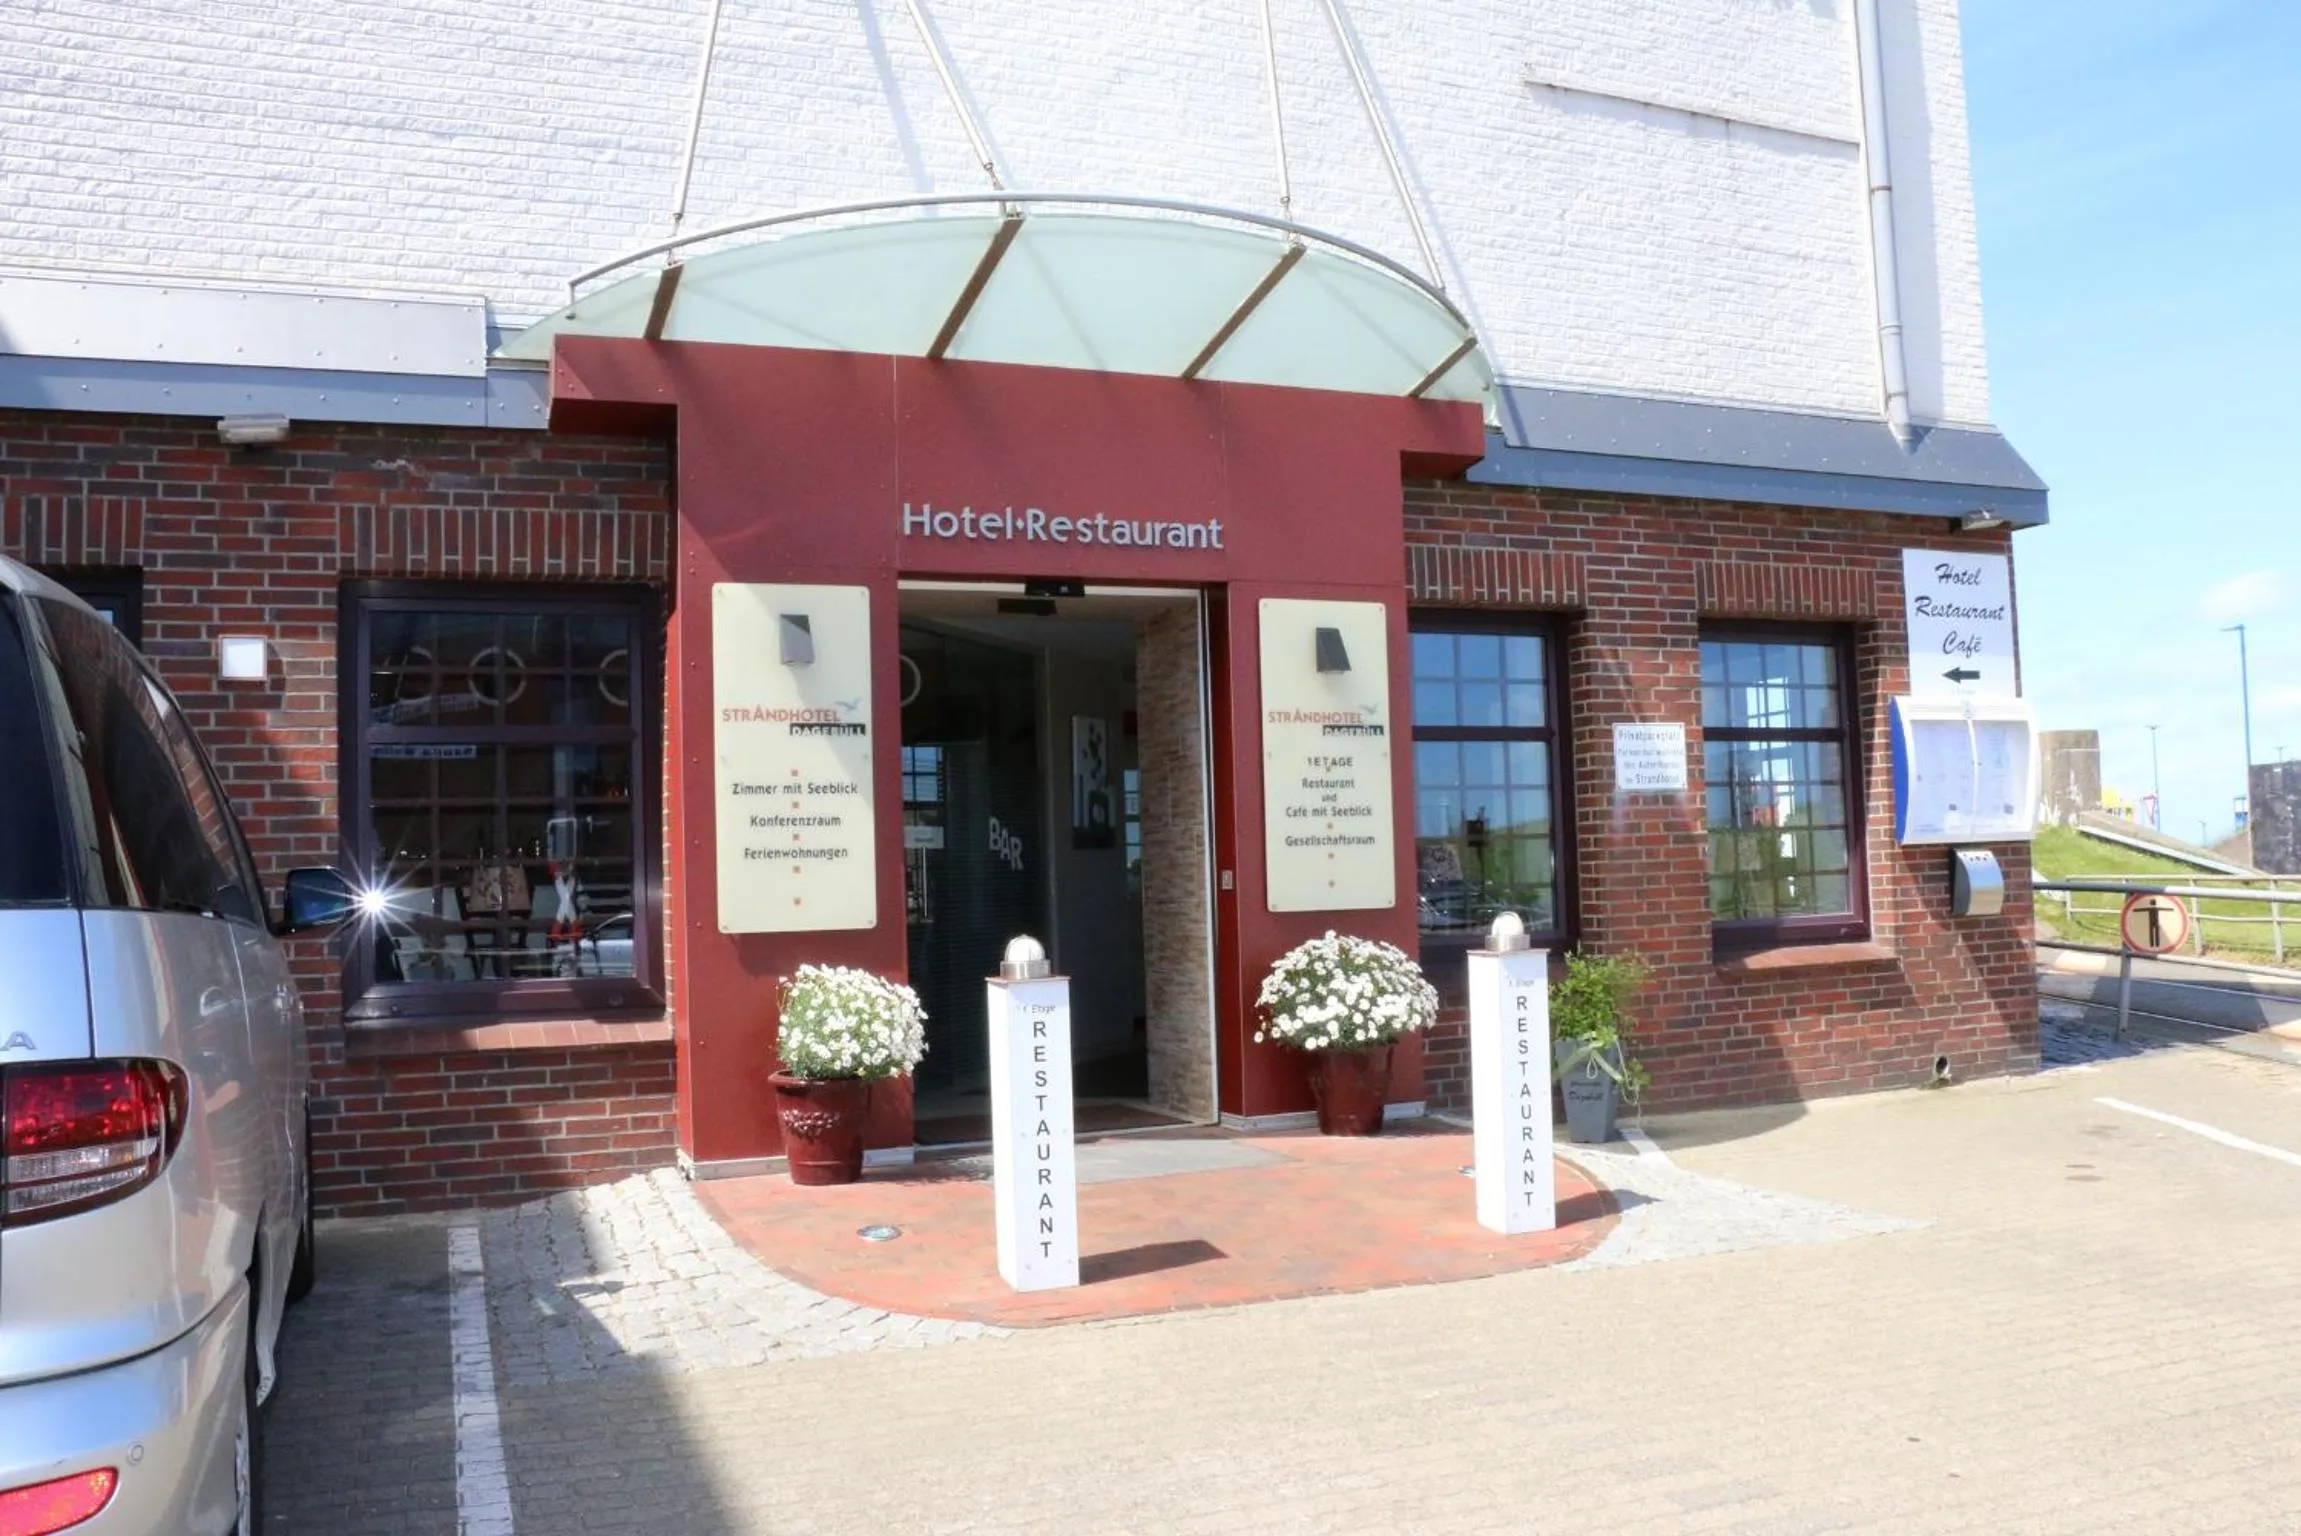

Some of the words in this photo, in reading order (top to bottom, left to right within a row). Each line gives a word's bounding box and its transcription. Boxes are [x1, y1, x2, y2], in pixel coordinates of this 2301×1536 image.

[1934, 562, 1982, 586] Hotel
[1914, 595, 2005, 621] Restaurant
[1942, 630, 1983, 659] Café
[732, 782, 778, 795] Zimmer
[783, 782, 802, 795] mit
[807, 782, 858, 795] Seeblick
[1301, 777, 1355, 788] Restaurant
[1321, 793, 1337, 802] und
[1311, 806, 1328, 817] mit
[1331, 805, 1373, 817] Seeblick
[750, 814, 841, 828] Konferenzraum
[988, 816, 1024, 872] BAR
[1285, 834, 1376, 847] Gesellschaftsraum
[744, 847, 848, 860] Ferienwohnungen
[1516, 995, 1535, 1207] RESTAURANT
[1033, 1021, 1053, 1259] RESTAURANT
